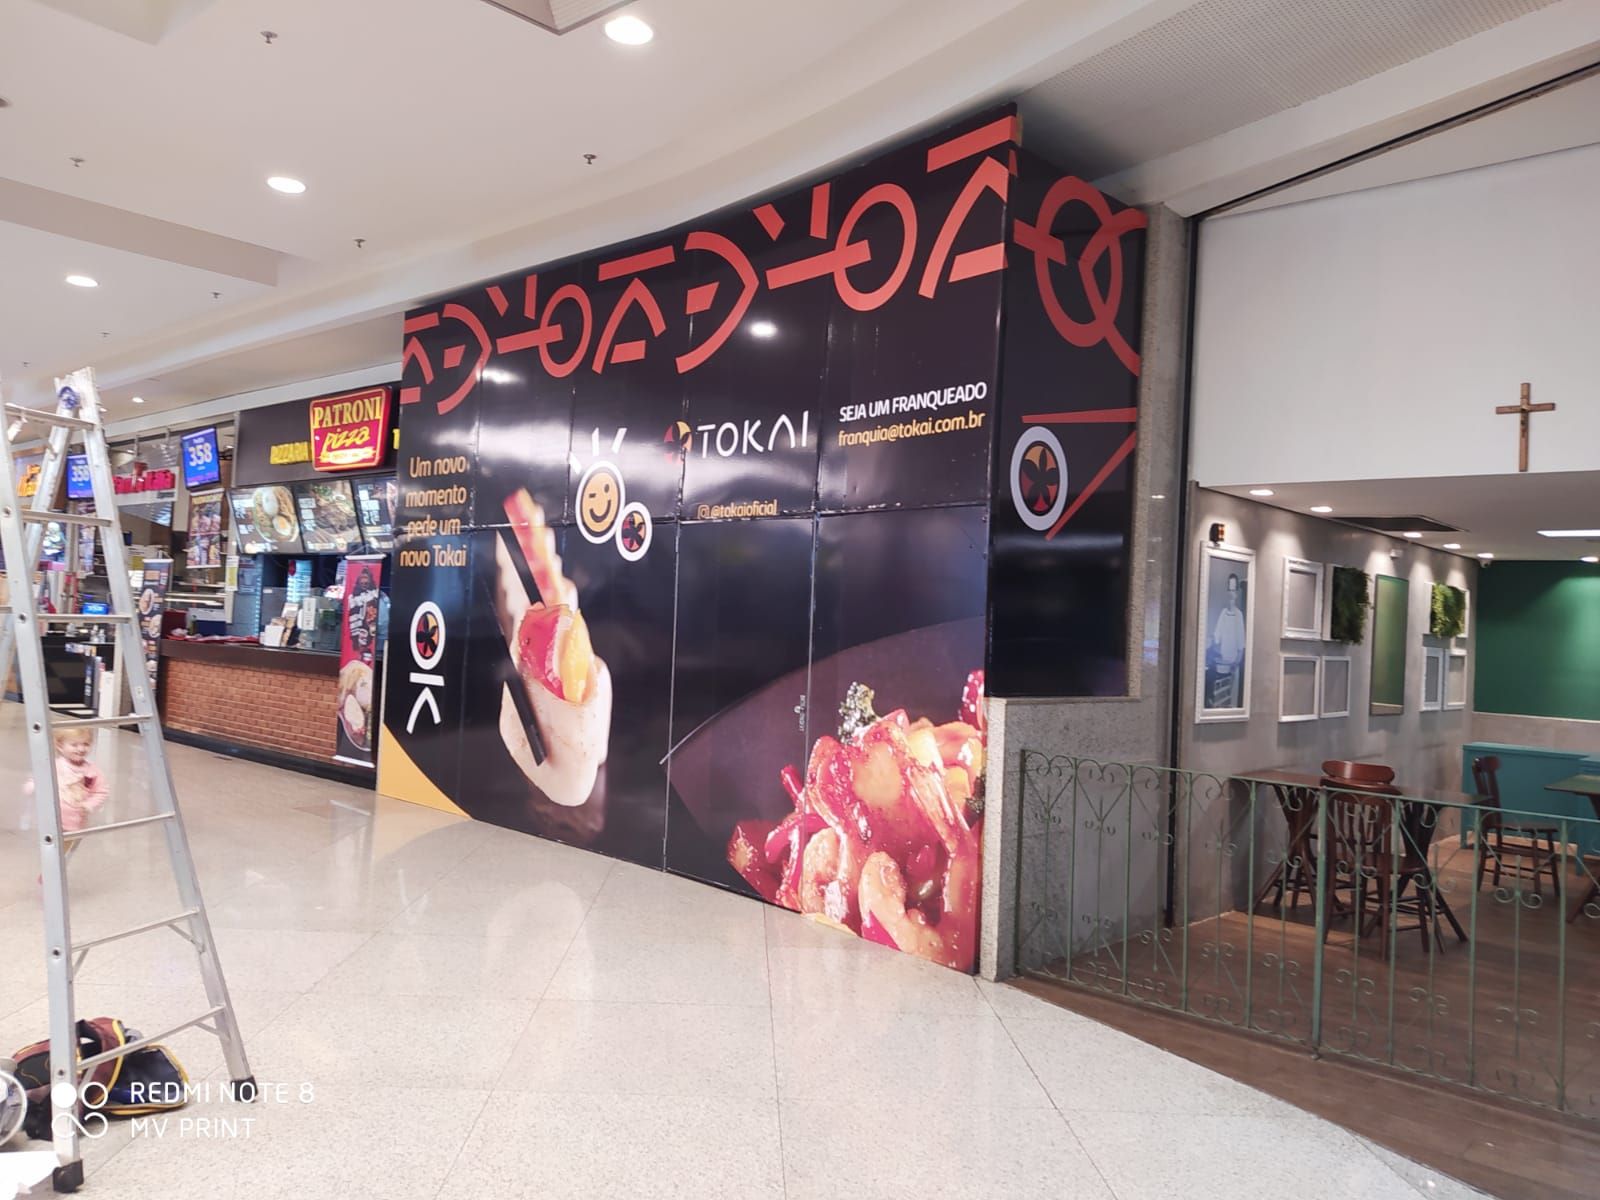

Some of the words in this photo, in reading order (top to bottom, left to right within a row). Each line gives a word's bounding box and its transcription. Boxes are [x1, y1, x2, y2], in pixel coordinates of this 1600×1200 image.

[312, 396, 382, 429] PATRONI
[839, 403, 867, 423] SEJA
[868, 399, 890, 418] UM
[892, 381, 988, 413] FRANQUEADO
[697, 410, 809, 458] TOKAI
[838, 409, 986, 447] franquia@tokai.com.br
[187, 442, 213, 468] 358
[409, 456, 432, 478] Um
[433, 456, 467, 475] novo
[405, 484, 467, 508] momento
[407, 514, 438, 542] pede
[439, 518, 462, 536] um
[399, 550, 430, 567] novo
[432, 543, 468, 567] Tokai
